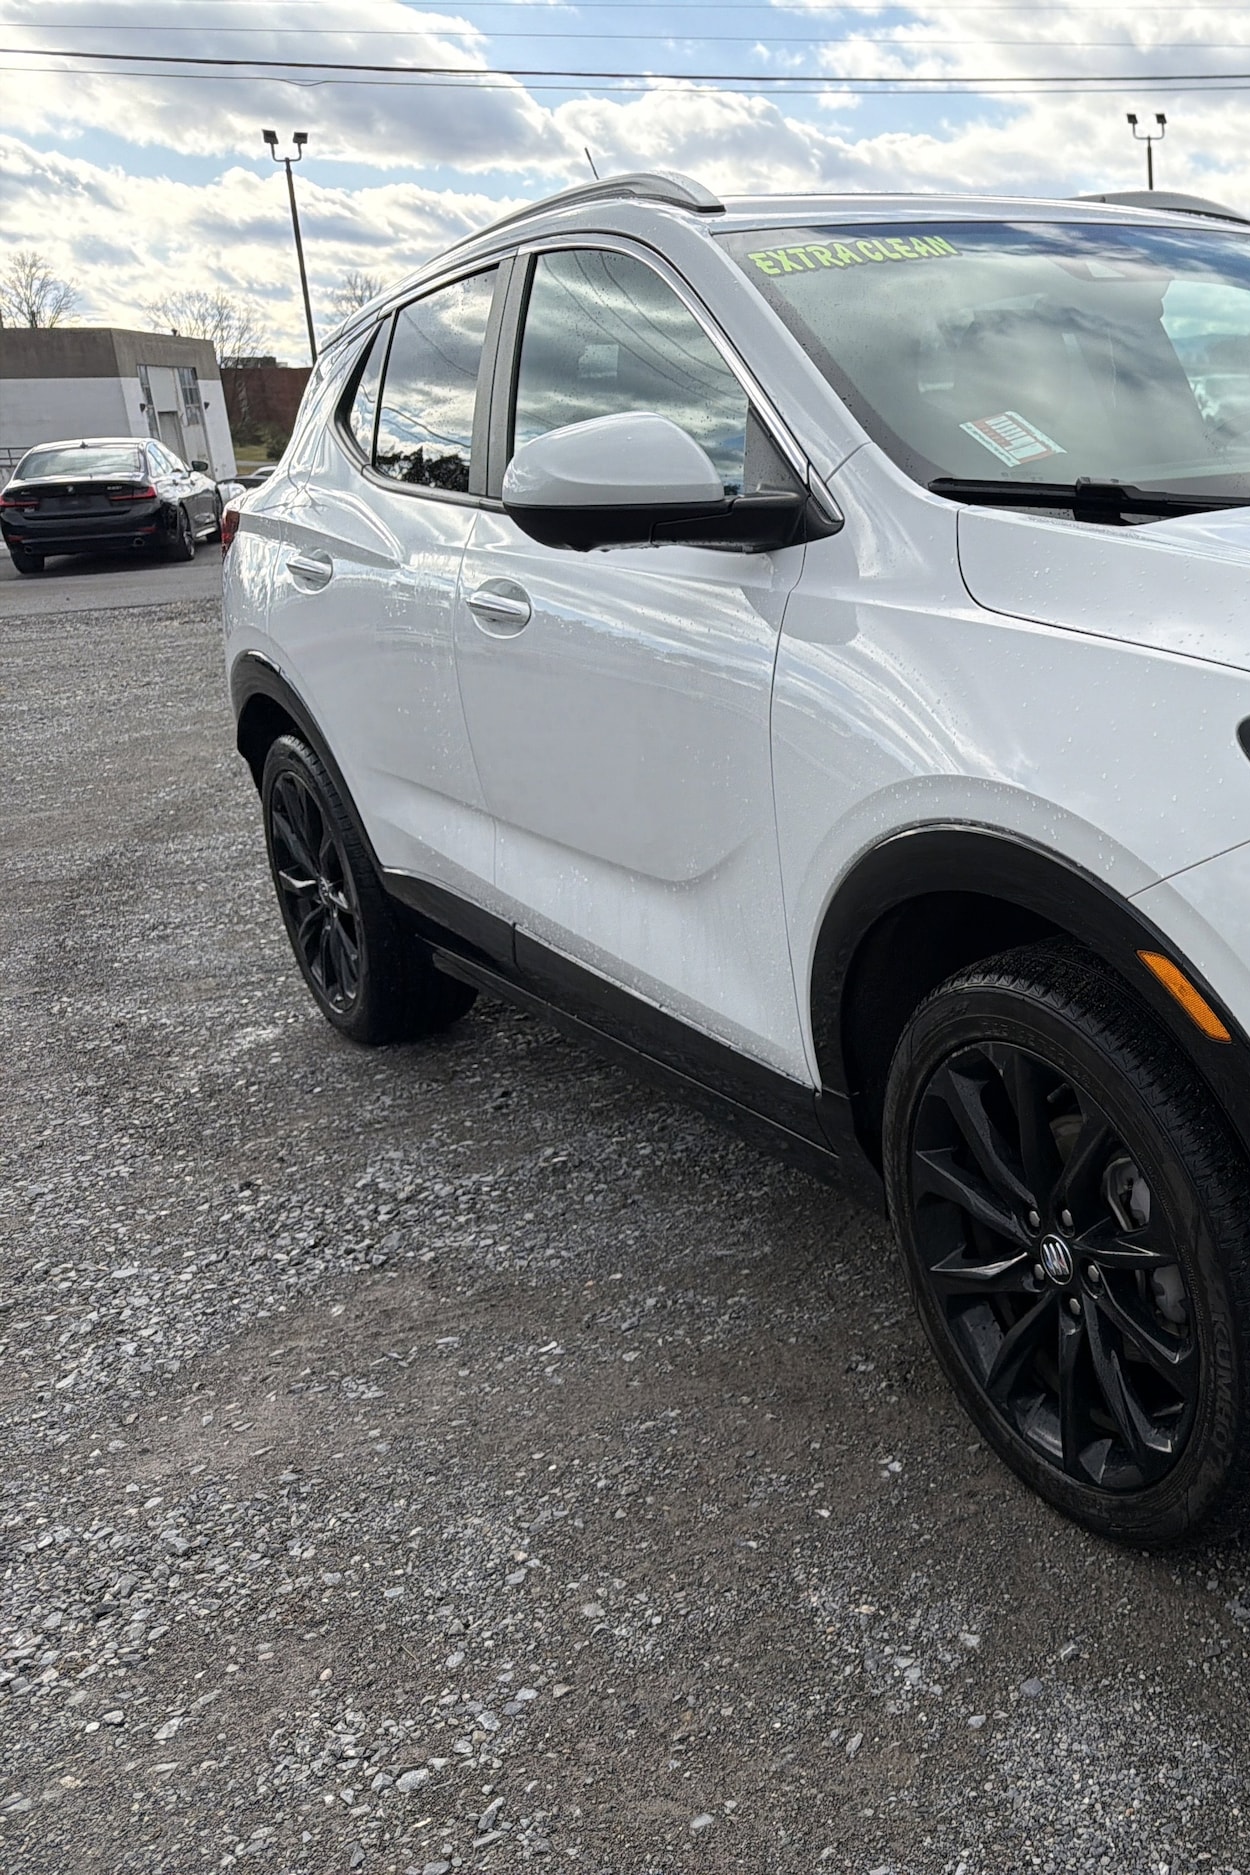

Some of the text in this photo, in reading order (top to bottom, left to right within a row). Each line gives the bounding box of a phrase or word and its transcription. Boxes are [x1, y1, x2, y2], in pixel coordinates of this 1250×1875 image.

[748, 235, 959, 275] EXTRA CLEAN
[1211, 1312, 1233, 1448] KUMHO
